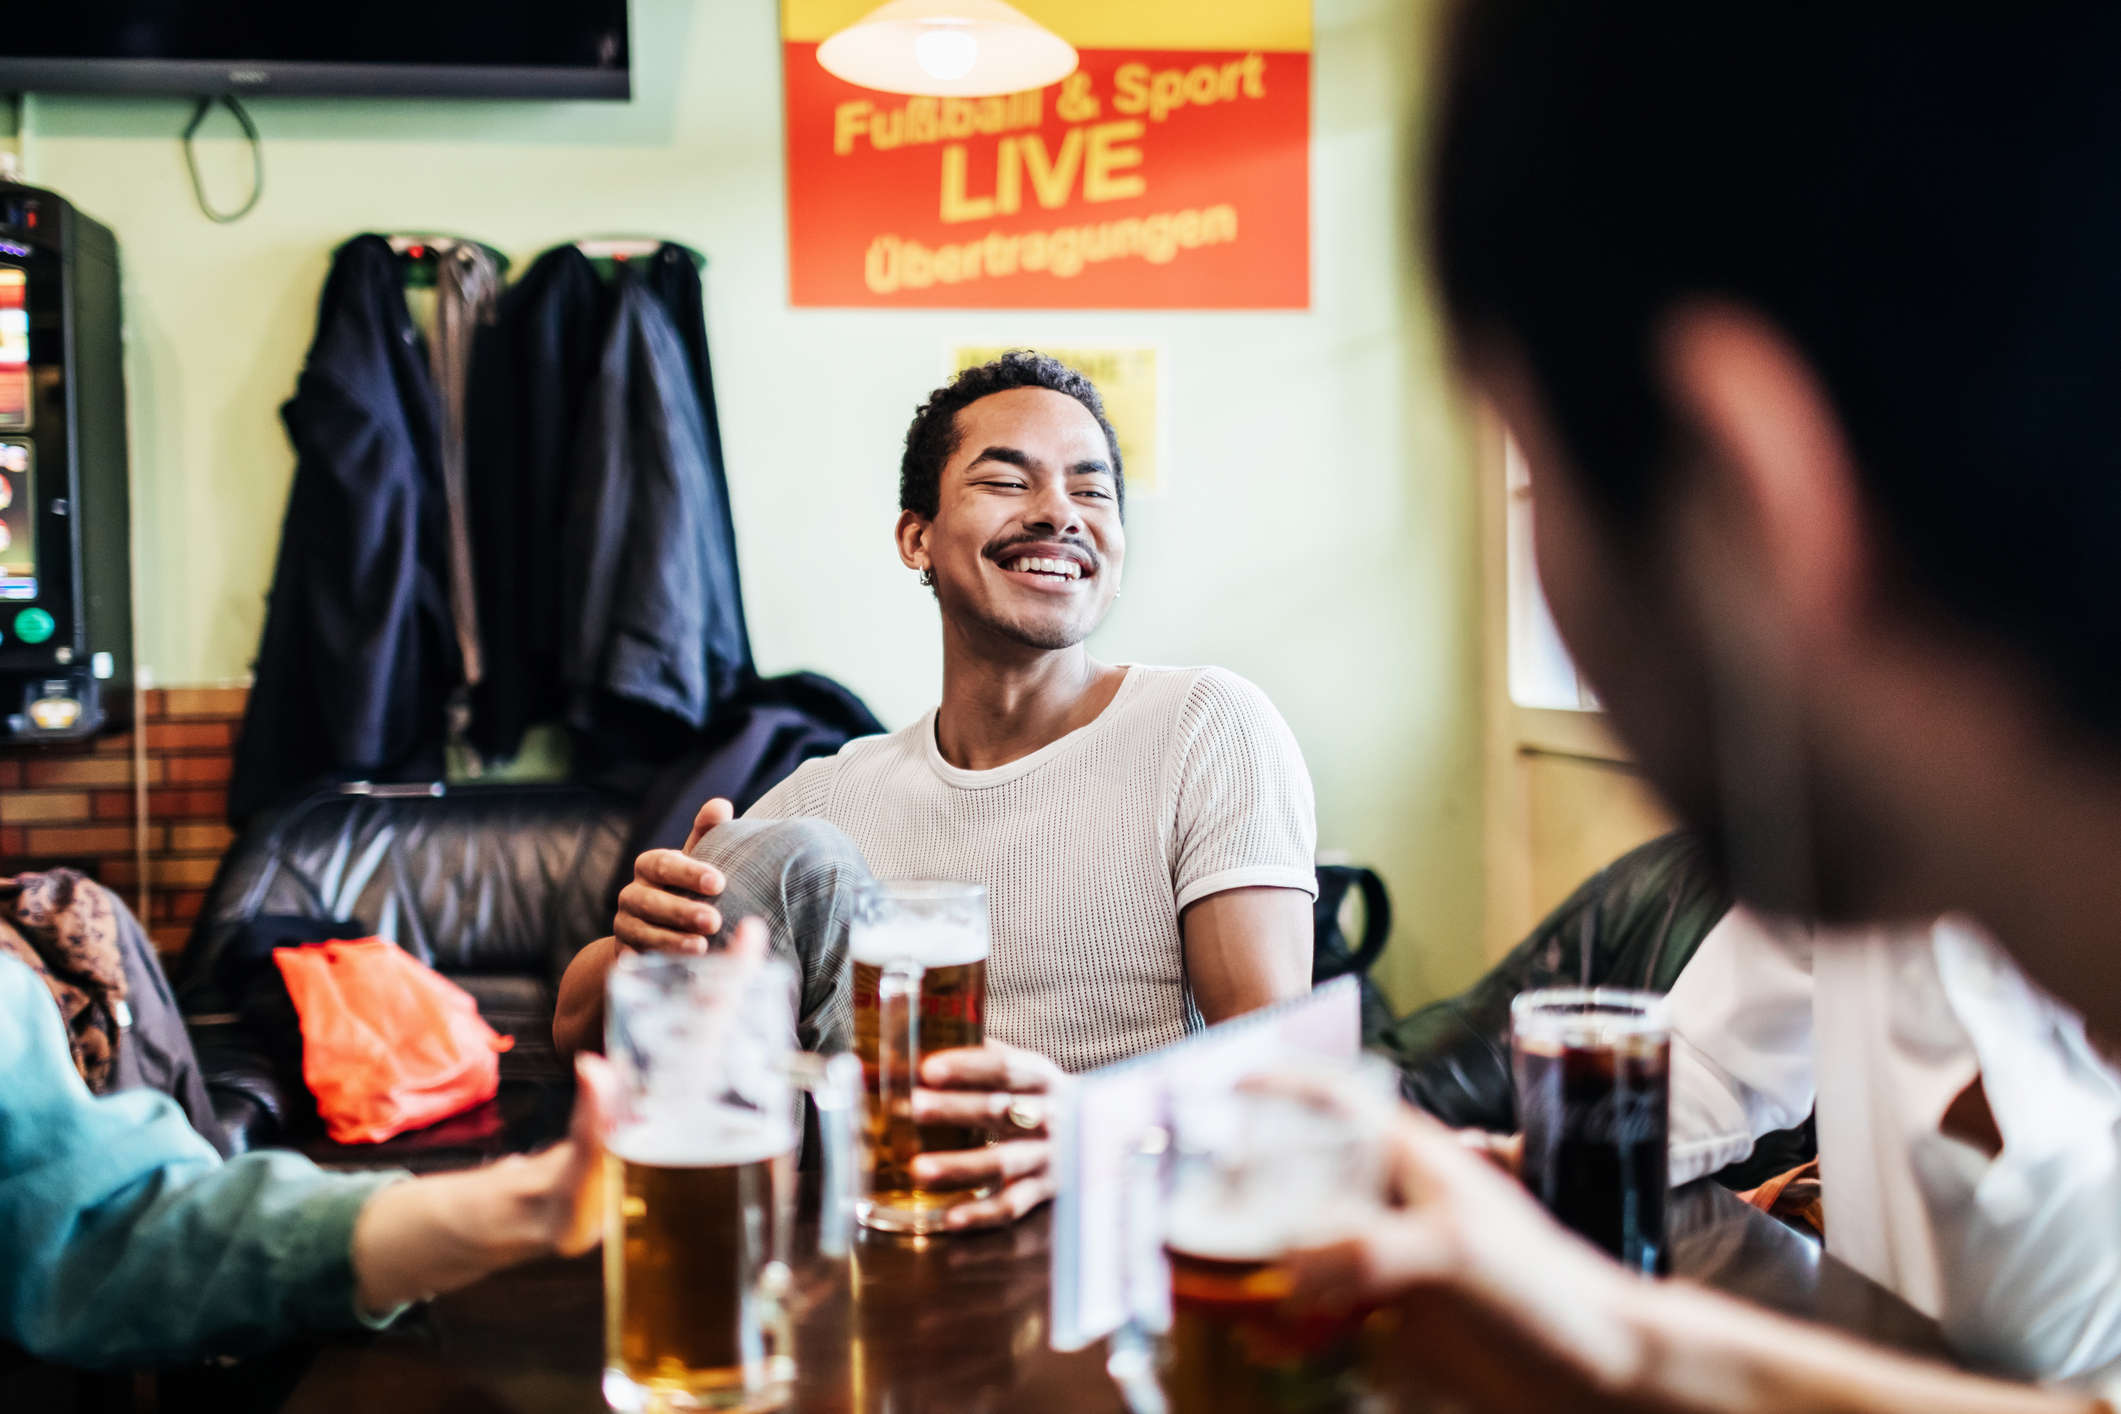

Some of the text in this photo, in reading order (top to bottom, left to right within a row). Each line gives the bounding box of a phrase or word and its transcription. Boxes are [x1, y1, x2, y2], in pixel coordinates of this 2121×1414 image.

[834, 52, 1265, 155] Fußball & Sport
[940, 119, 1146, 223] LIVE
[865, 204, 1238, 293] Übertragungen
